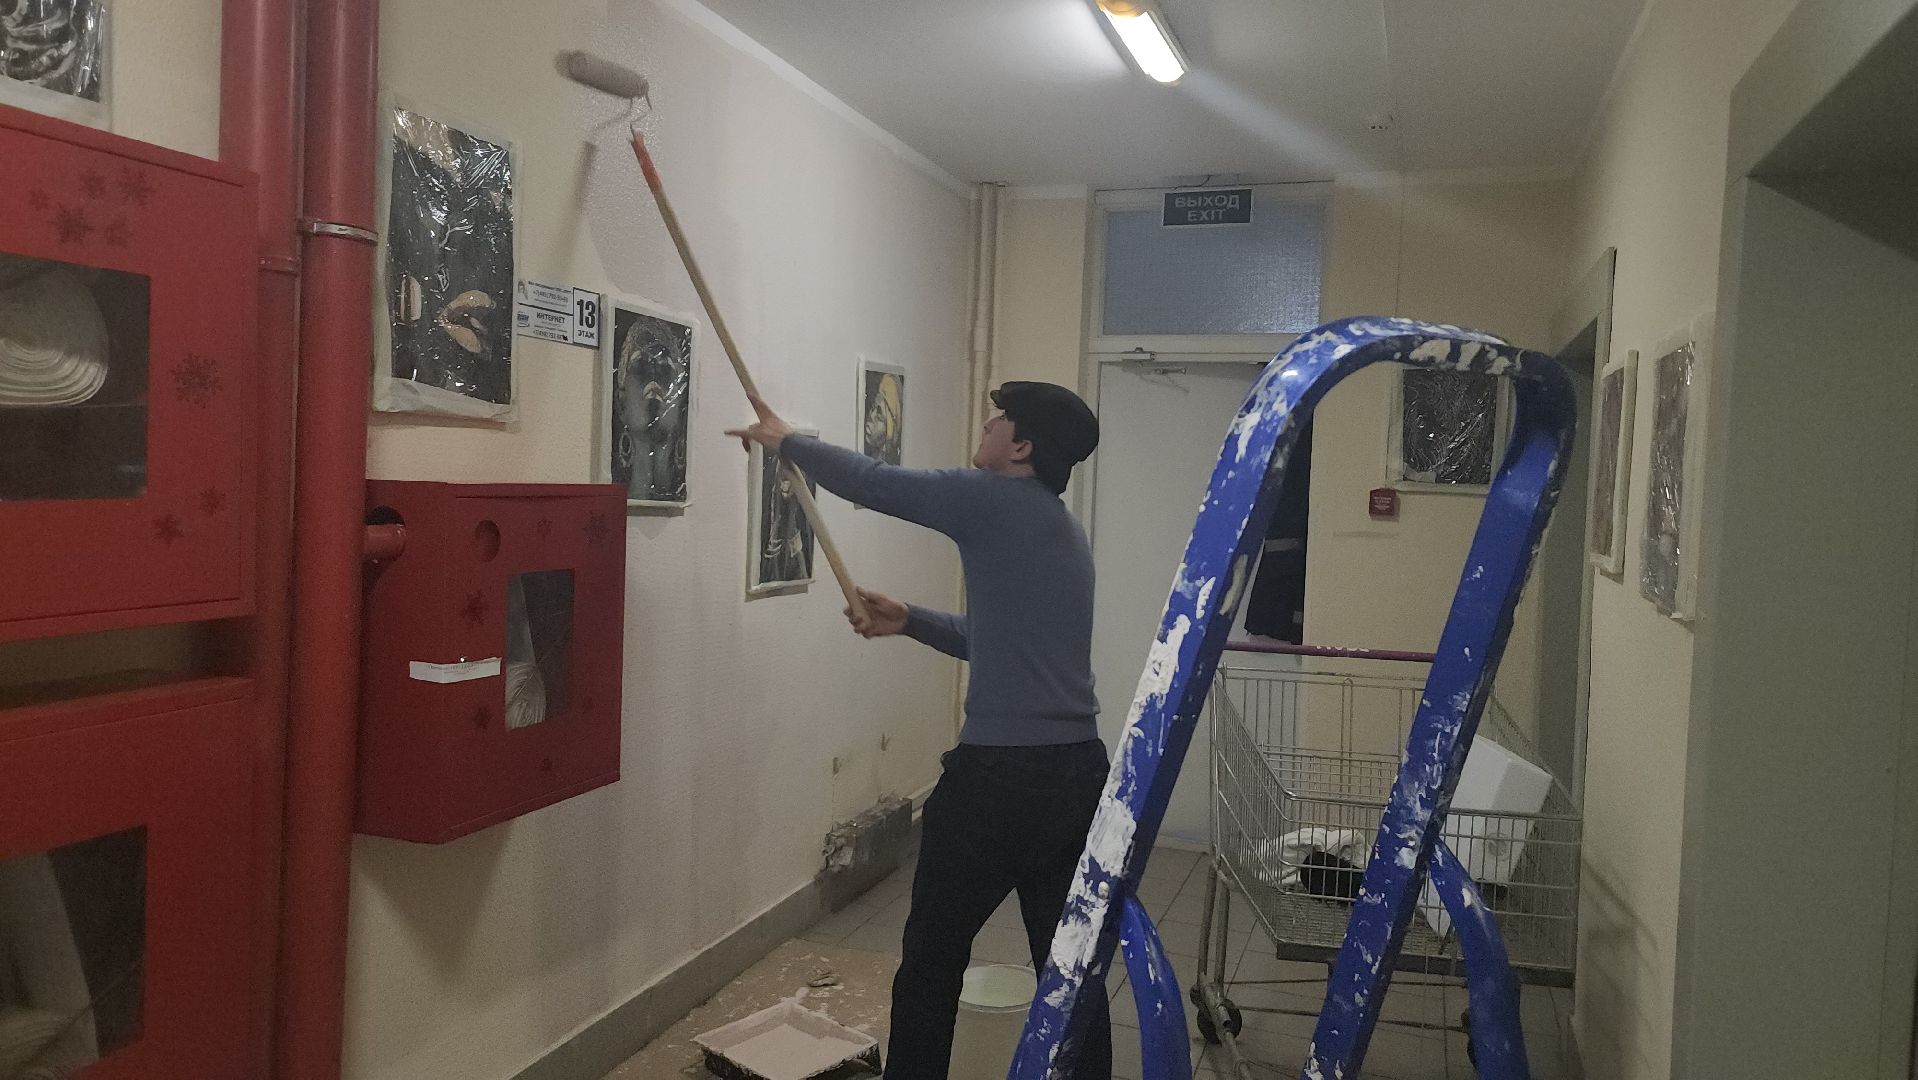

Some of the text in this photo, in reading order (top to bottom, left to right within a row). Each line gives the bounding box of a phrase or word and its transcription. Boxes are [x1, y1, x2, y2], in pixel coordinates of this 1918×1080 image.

[1174, 195, 1239, 209] ВЫХОД
[1187, 209, 1226, 221] EXIT
[536, 312, 565, 324] ИНТЕРНЕТ
[577, 299, 596, 328] 13
[578, 329, 595, 339] ЭТАЖ
